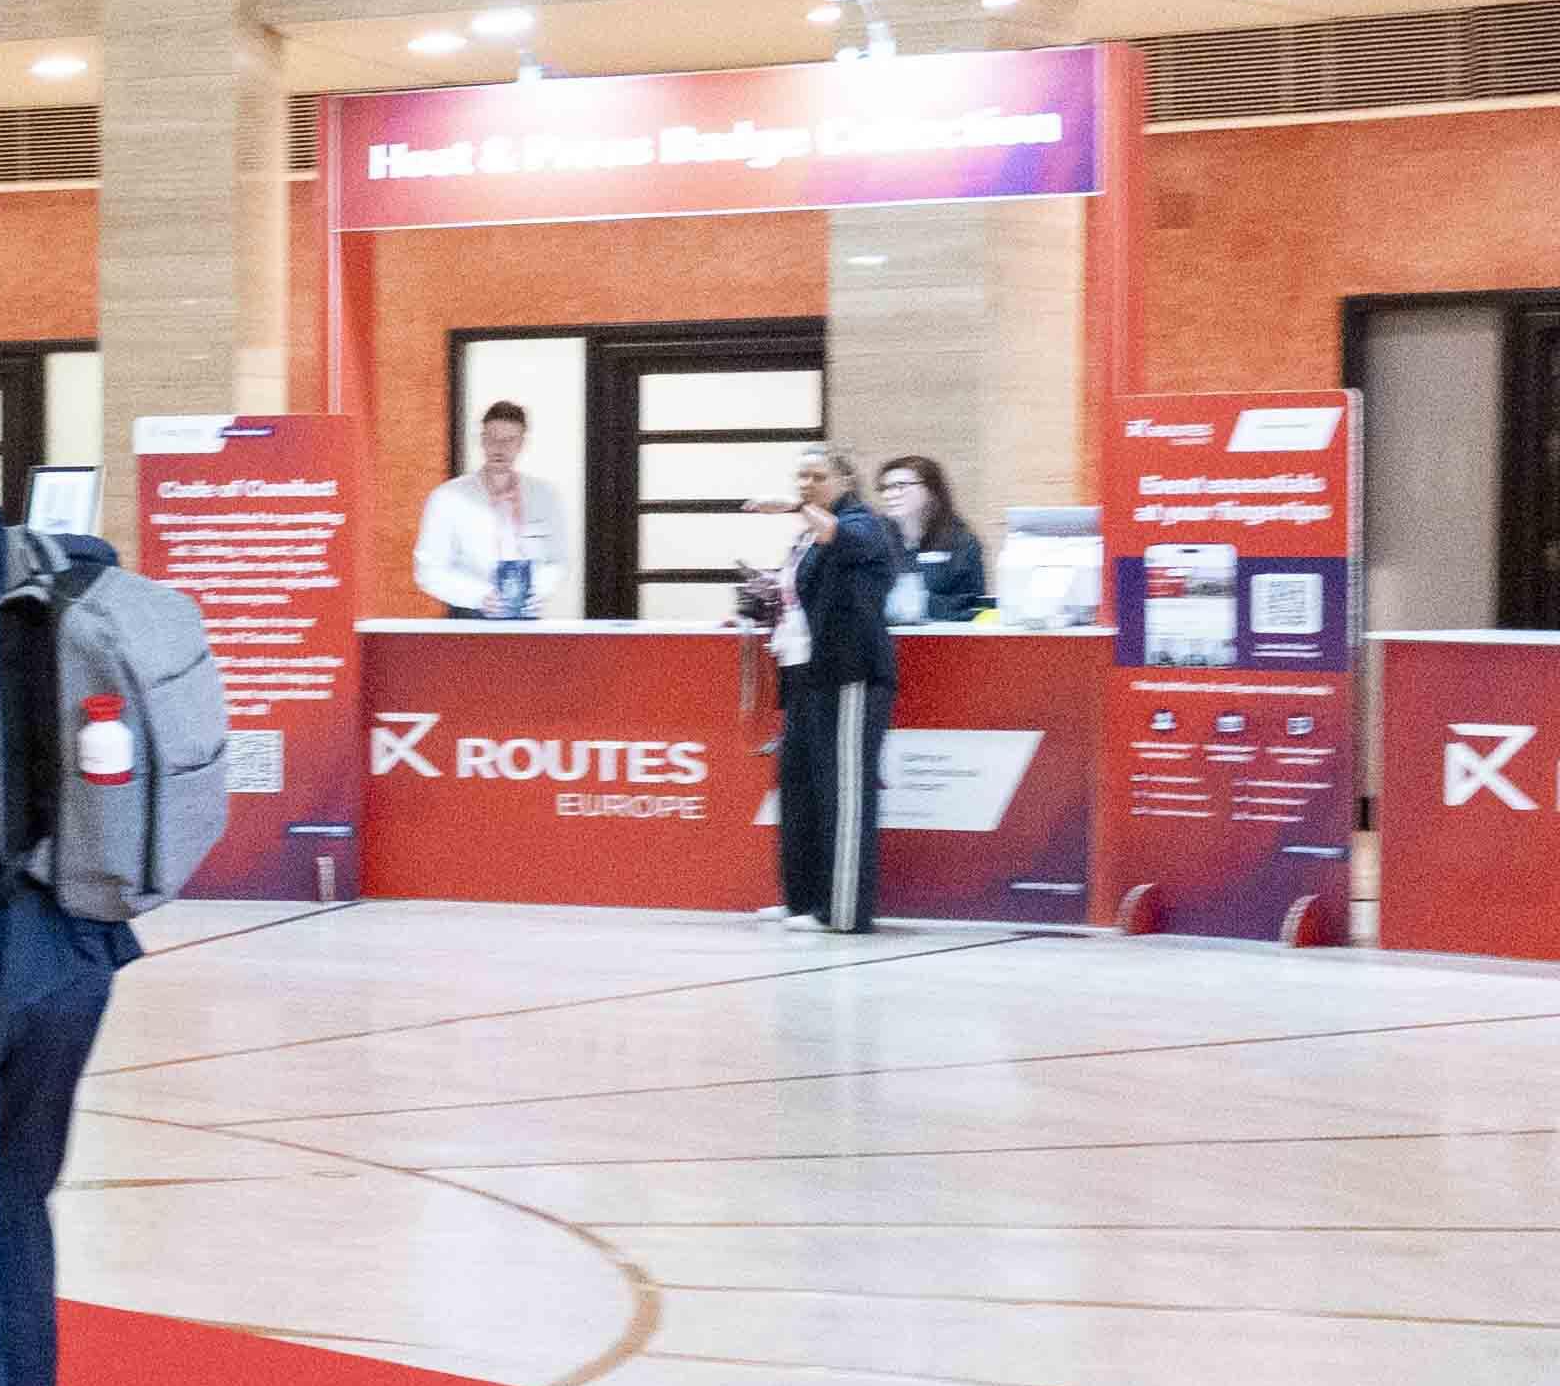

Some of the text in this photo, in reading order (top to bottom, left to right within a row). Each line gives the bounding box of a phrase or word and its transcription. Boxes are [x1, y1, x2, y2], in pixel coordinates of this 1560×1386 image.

[659, 120, 810, 169] Badge
[157, 479, 217, 499] Code
[219, 479, 245, 498] of
[455, 737, 709, 784] ROUTES
[555, 792, 706, 820] EUROPE
